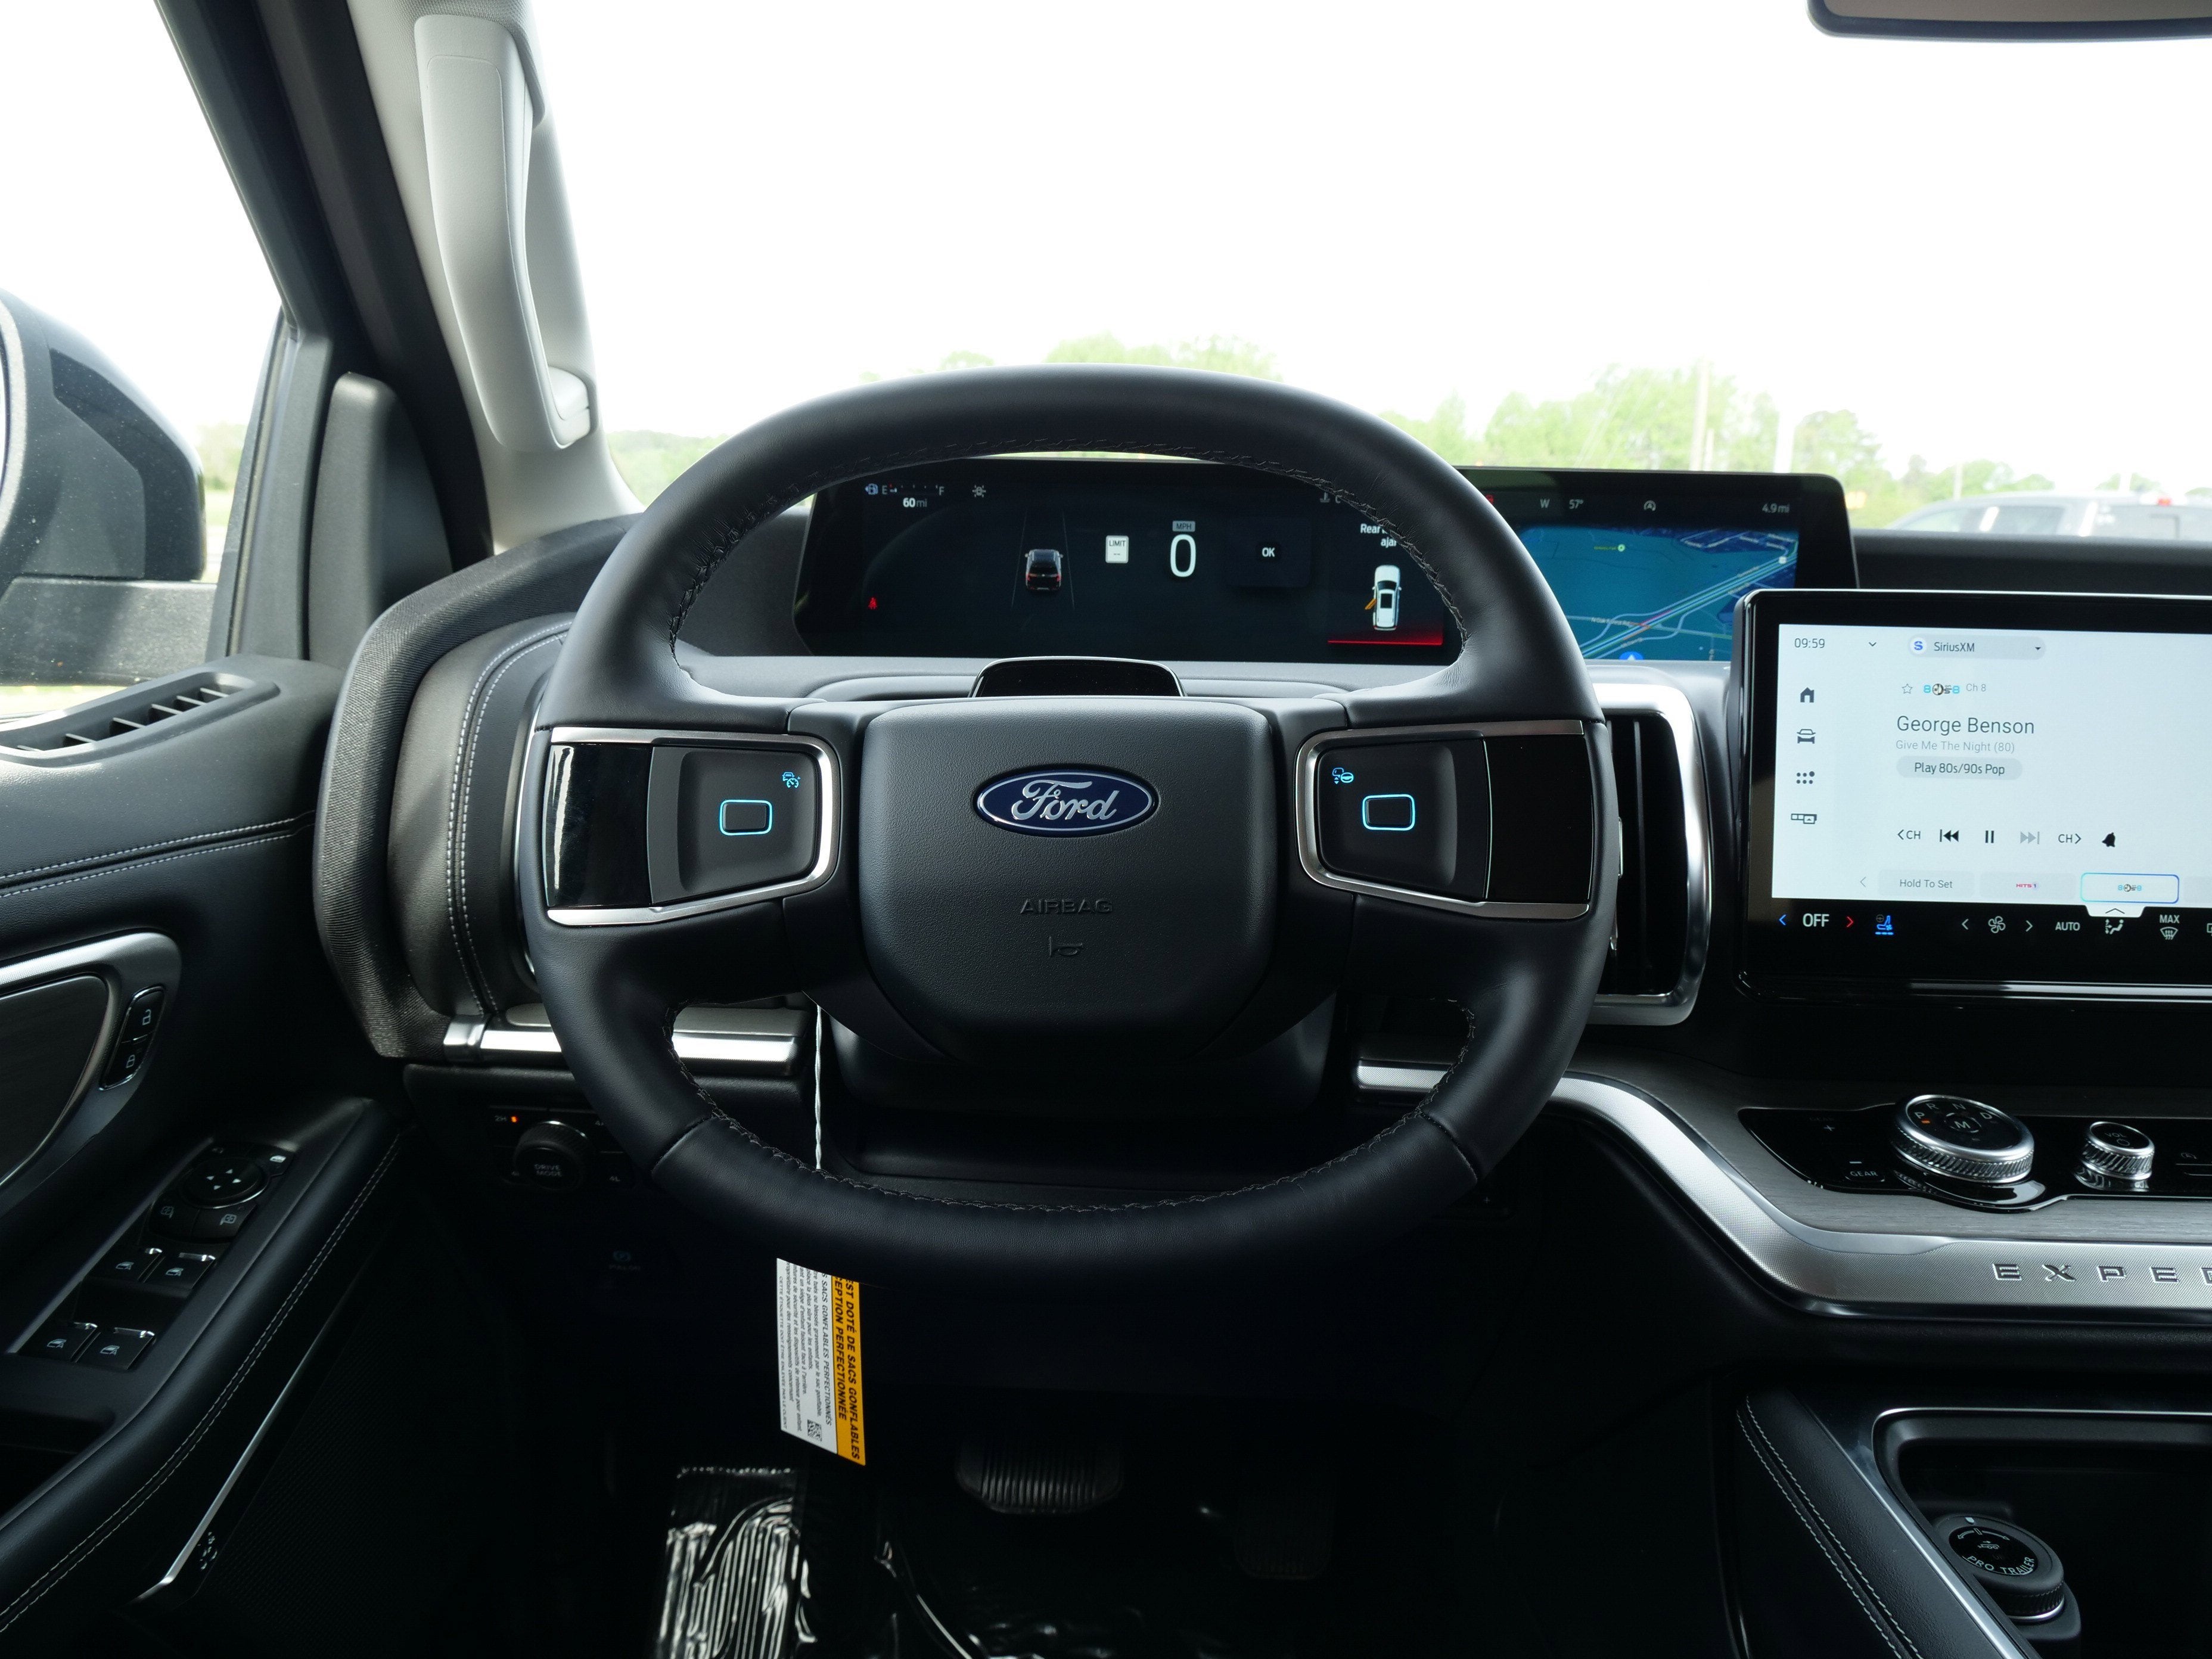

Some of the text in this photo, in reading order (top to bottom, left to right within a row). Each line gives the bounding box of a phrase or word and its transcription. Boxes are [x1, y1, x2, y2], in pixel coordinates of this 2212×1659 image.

[1540, 499, 1550, 508] W
[1360, 523, 1381, 534] Rear
[1170, 534, 1196, 577] 0
[1262, 547, 1275, 557] OK
[1794, 638, 1825, 649] 09:59
[1934, 642, 1975, 653] SiriusXM
[1966, 683, 1986, 692] Ch 8
[1896, 715, 2035, 736] George Benson
[1896, 740, 2015, 754] Give Me The Night (80)
[1914, 762, 2005, 778] Play 80s/90s Pop
[1011, 779, 1120, 821] Ford
[1906, 830, 1921, 840] CH
[2058, 834, 2074, 844] CH
[1899, 878, 1953, 889] Hold To Set
[1020, 899, 1113, 915] AIRBAG
[1803, 914, 1829, 927] OFF
[2159, 914, 2180, 924] MAX
[2055, 922, 2080, 931] AUTO
[1926, 1102, 1940, 1111] R
[1952, 1102, 1966, 1111] N
[1953, 1120, 1970, 1129] M
[846, 1300, 857, 1333] DOTÉ
[847, 1335, 855, 1352] DE
[836, 1326, 849, 1421] PERFECTIONNÉE
[848, 1354, 857, 1385] SACS
[824, 1360, 832, 1425] PERFECTIONNÉS
[849, 1387, 860, 1460] GONFLABLES
[1966, 1555, 1995, 1571] PRO
[2000, 1557, 2036, 1576] TRAILER
